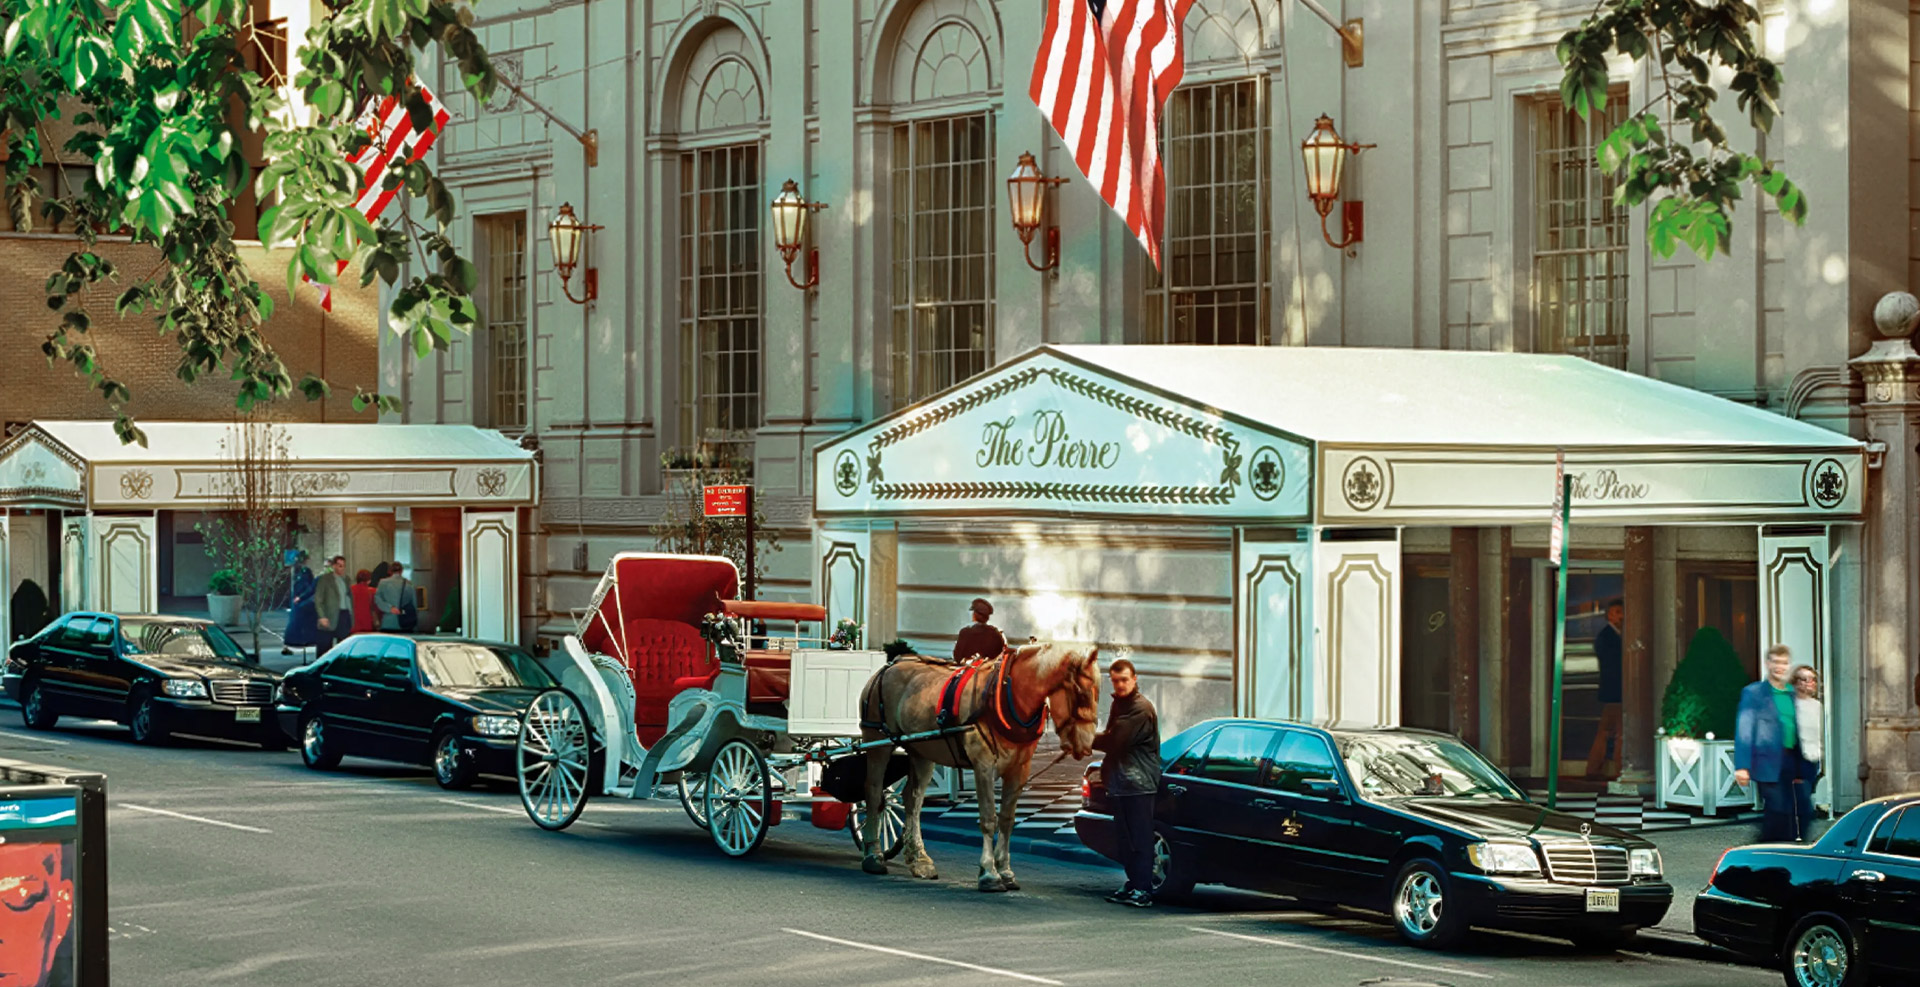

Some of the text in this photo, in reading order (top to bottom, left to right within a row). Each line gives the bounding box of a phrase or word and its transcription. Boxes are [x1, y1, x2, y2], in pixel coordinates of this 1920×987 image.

[976, 410, 1121, 469] The Pierre
[1593, 468, 1650, 500] Pierre
